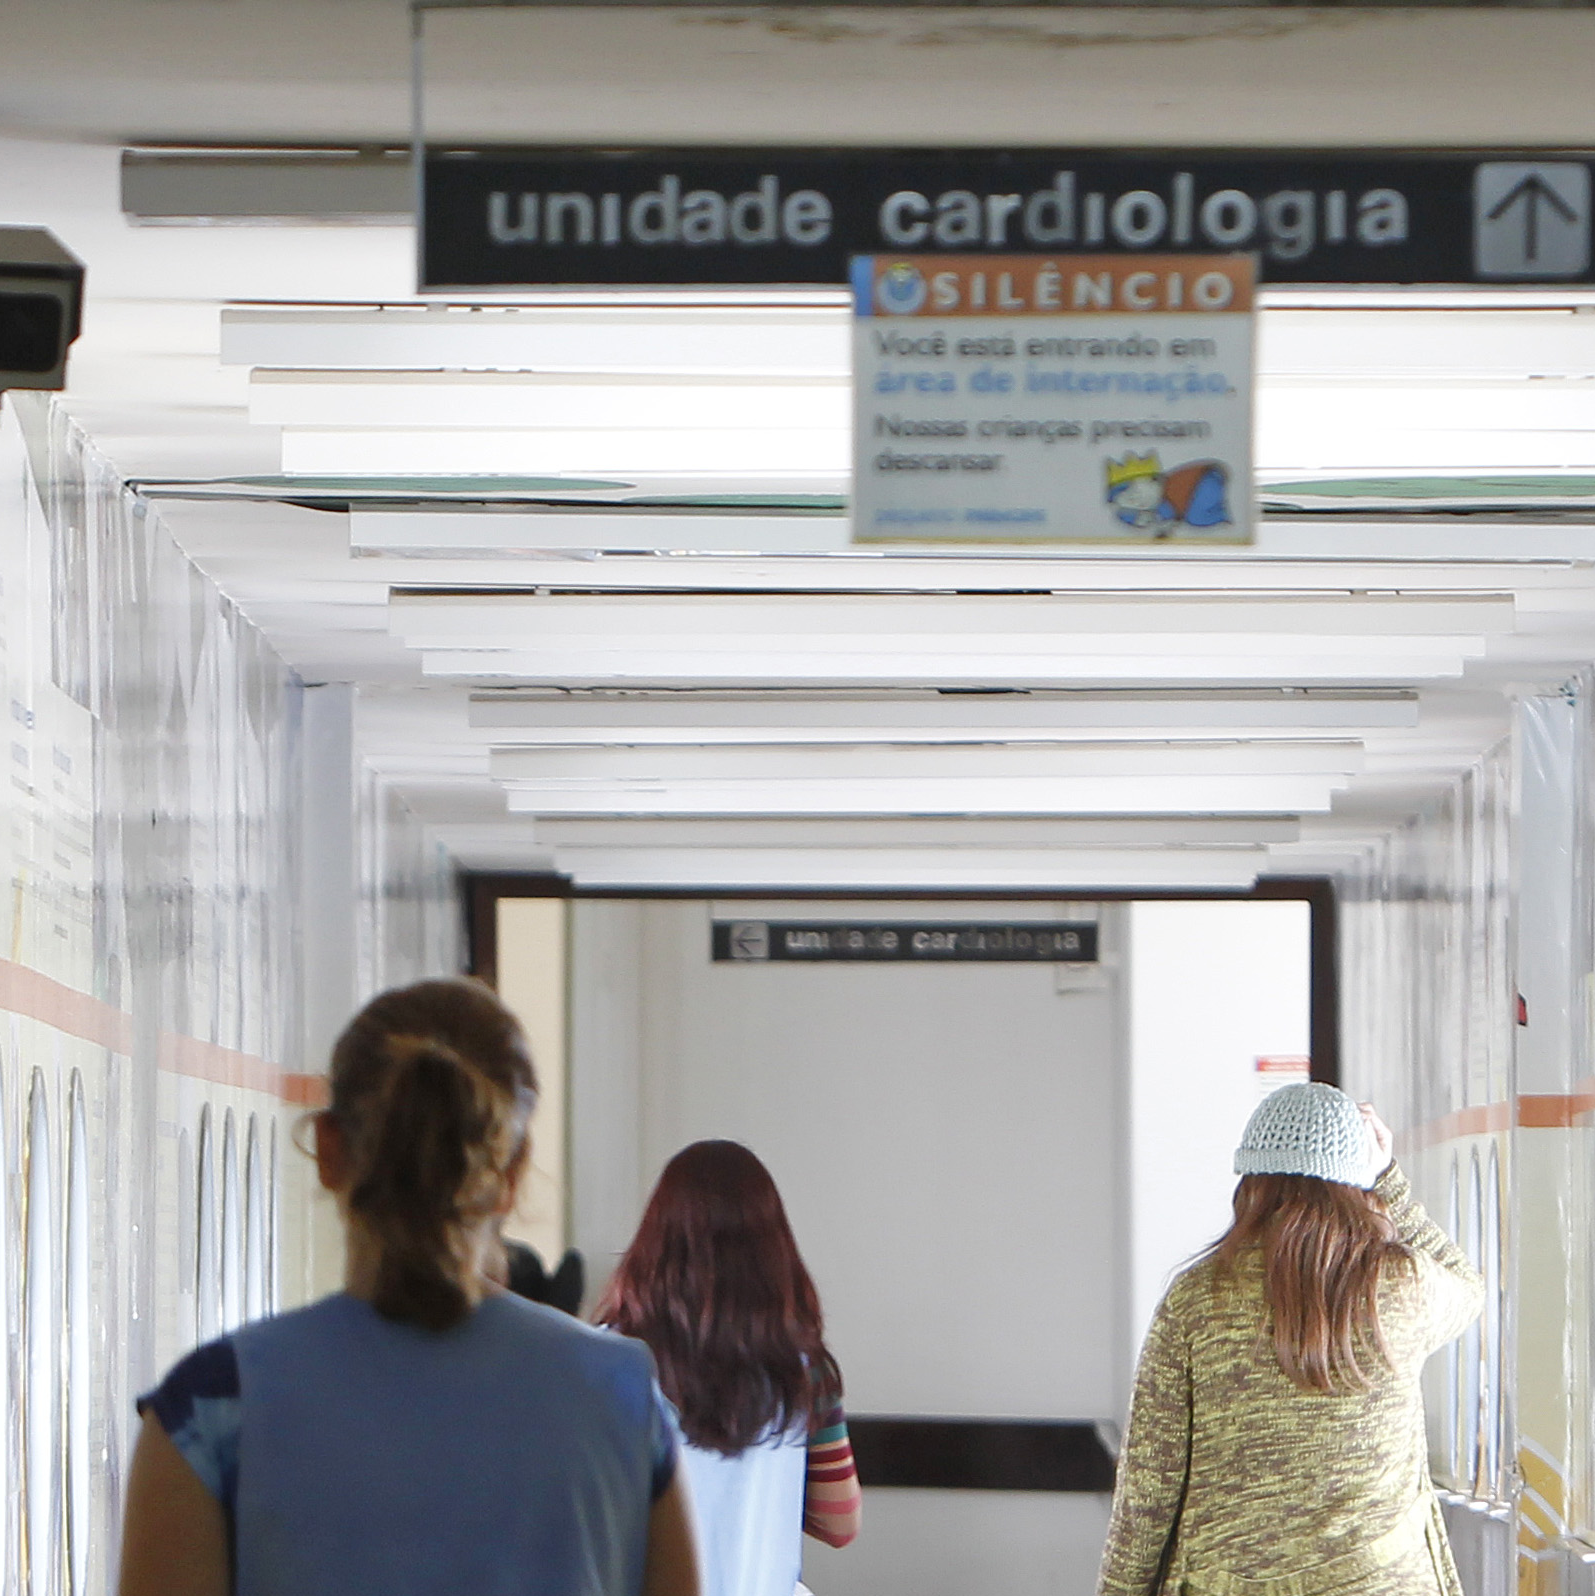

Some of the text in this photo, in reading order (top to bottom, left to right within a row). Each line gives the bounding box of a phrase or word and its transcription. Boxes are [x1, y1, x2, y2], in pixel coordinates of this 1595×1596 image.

[487, 170, 1410, 260] unidade cardiologia
[930, 260, 1235, 311] SILÊNCIO
[874, 328, 1216, 357] Você está entrando em
[874, 362, 957, 394] área
[969, 363, 1014, 394] de
[874, 413, 1212, 444] Nossas crianças precisam
[784, 927, 1081, 955] unidade cardiologia
